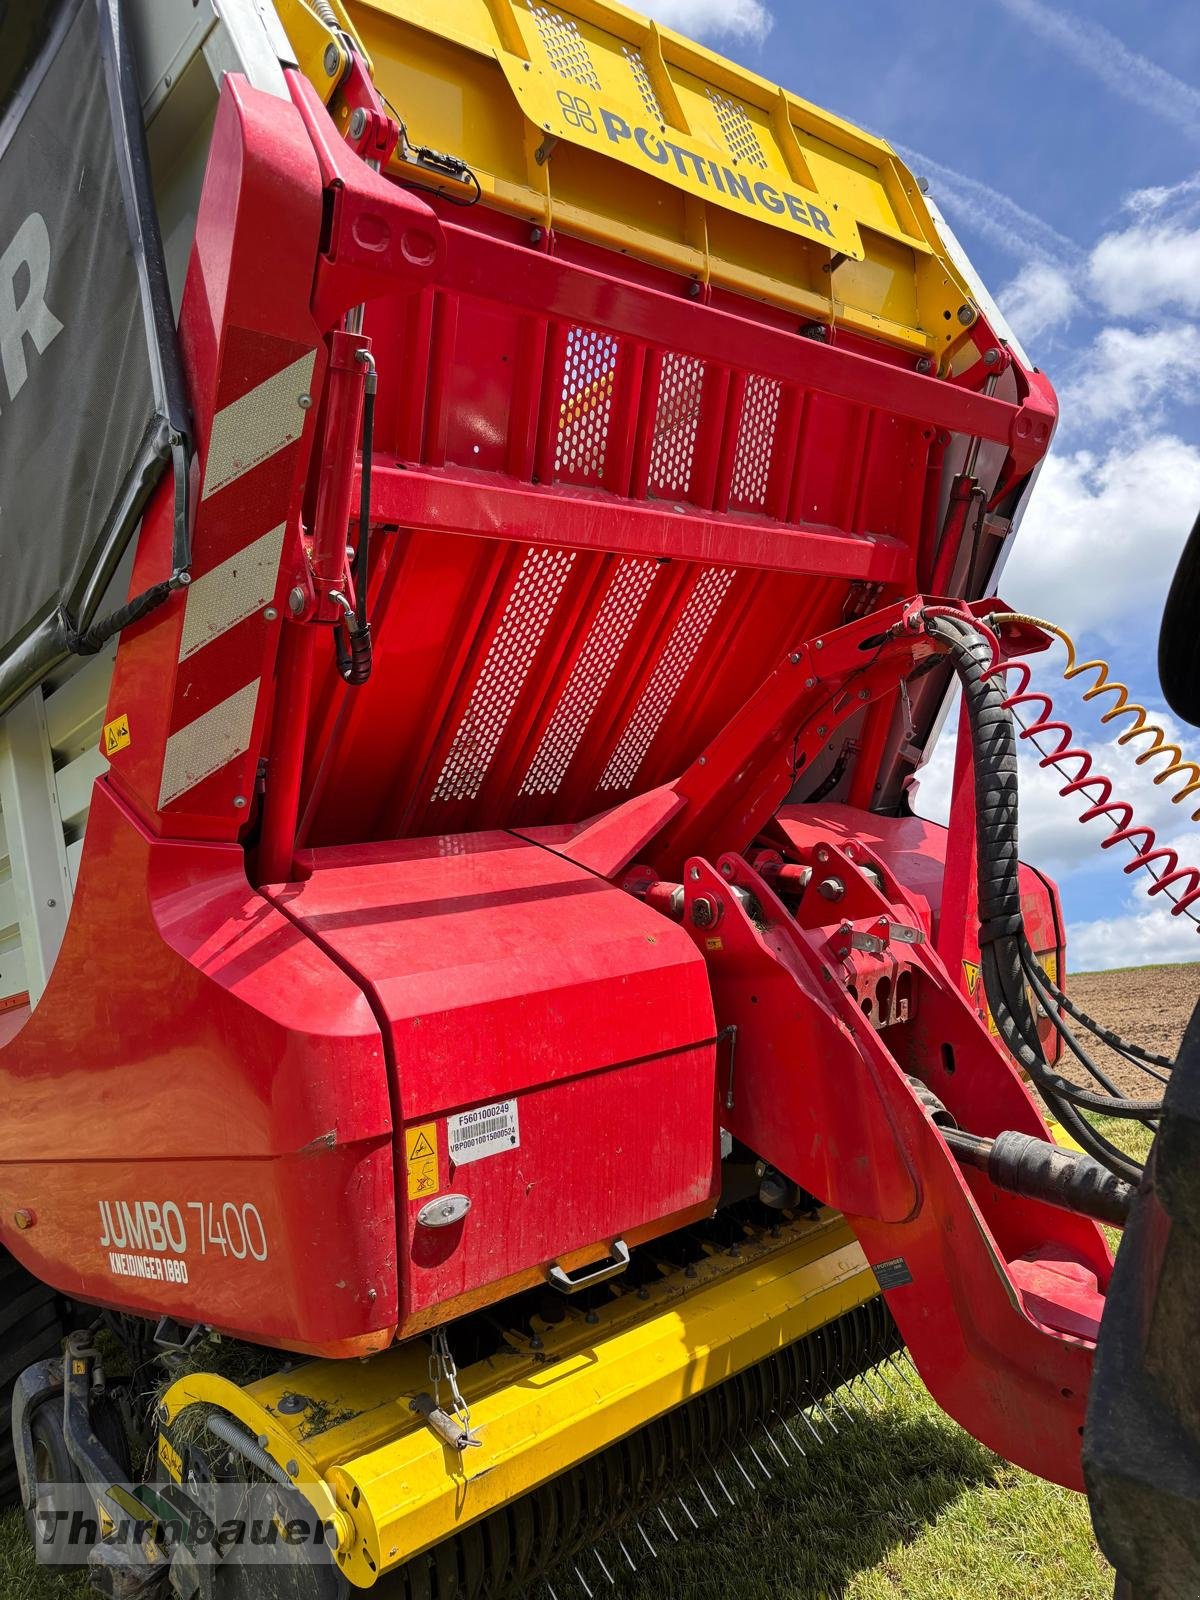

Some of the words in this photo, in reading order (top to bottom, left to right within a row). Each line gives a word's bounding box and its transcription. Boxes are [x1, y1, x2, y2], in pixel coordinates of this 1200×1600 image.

[599, 107, 837, 239] PÖTTINGER
[458, 1103, 509, 1126] F5601000249
[450, 1126, 515, 1152] VBP00010015000524
[99, 1200, 187, 1254] JUMBO
[187, 1202, 268, 1262] 7400
[109, 1252, 164, 1281] KNEIDINGER
[162, 1258, 189, 1285] 1880
